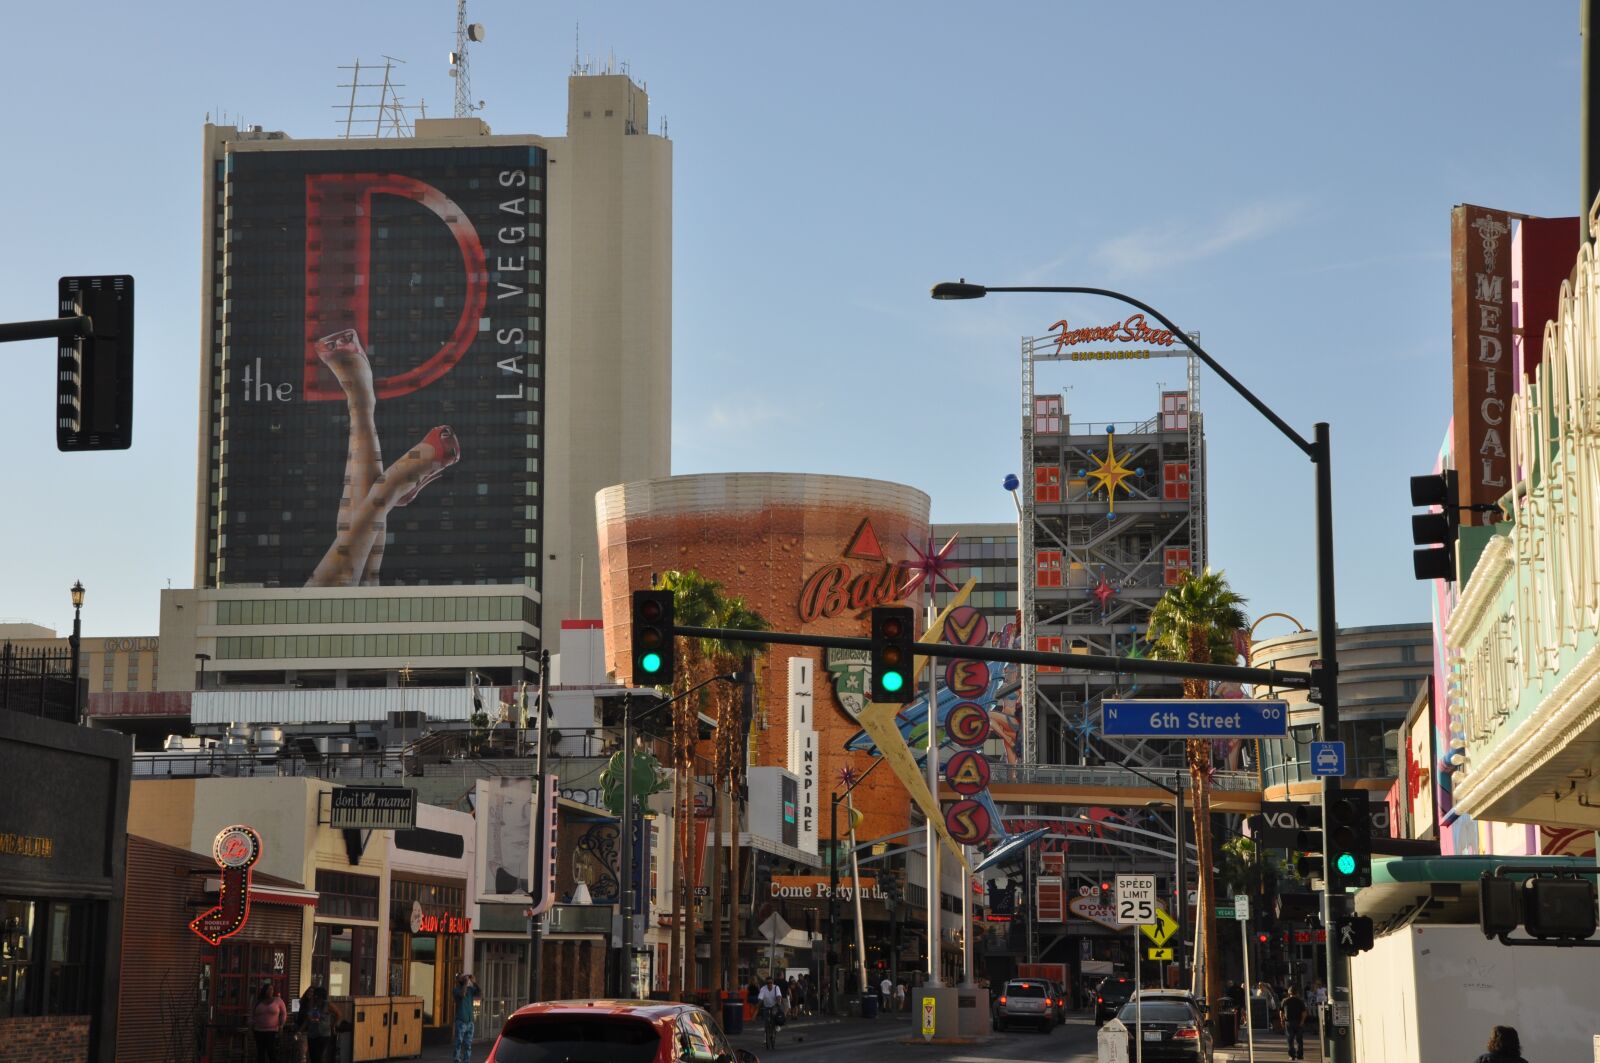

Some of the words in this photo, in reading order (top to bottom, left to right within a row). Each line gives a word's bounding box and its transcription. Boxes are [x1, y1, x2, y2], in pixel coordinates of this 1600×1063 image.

[496, 169, 526, 300] VEGAS
[1048, 319, 1121, 357] Fremont
[1119, 313, 1176, 347] Street
[495, 327, 525, 400] LAS
[1071, 349, 1150, 361] EXPERIENCE
[241, 357, 293, 402] the
[1474, 272, 1506, 488] MEDICAL
[948, 610, 985, 841] VEGAS
[1109, 708, 1118, 719] N
[1150, 712, 1180, 729] 6th
[1187, 712, 1241, 729] Street
[361, 792, 376, 807] tell
[377, 796, 410, 807] mama
[803, 737, 813, 833] INSPIRE
[770, 882, 812, 898] Come
[816, 882, 853, 902] Party
[1119, 880, 1153, 889] SPEED
[1123, 890, 1149, 899] LIMIT
[1120, 901, 1153, 919] 25
